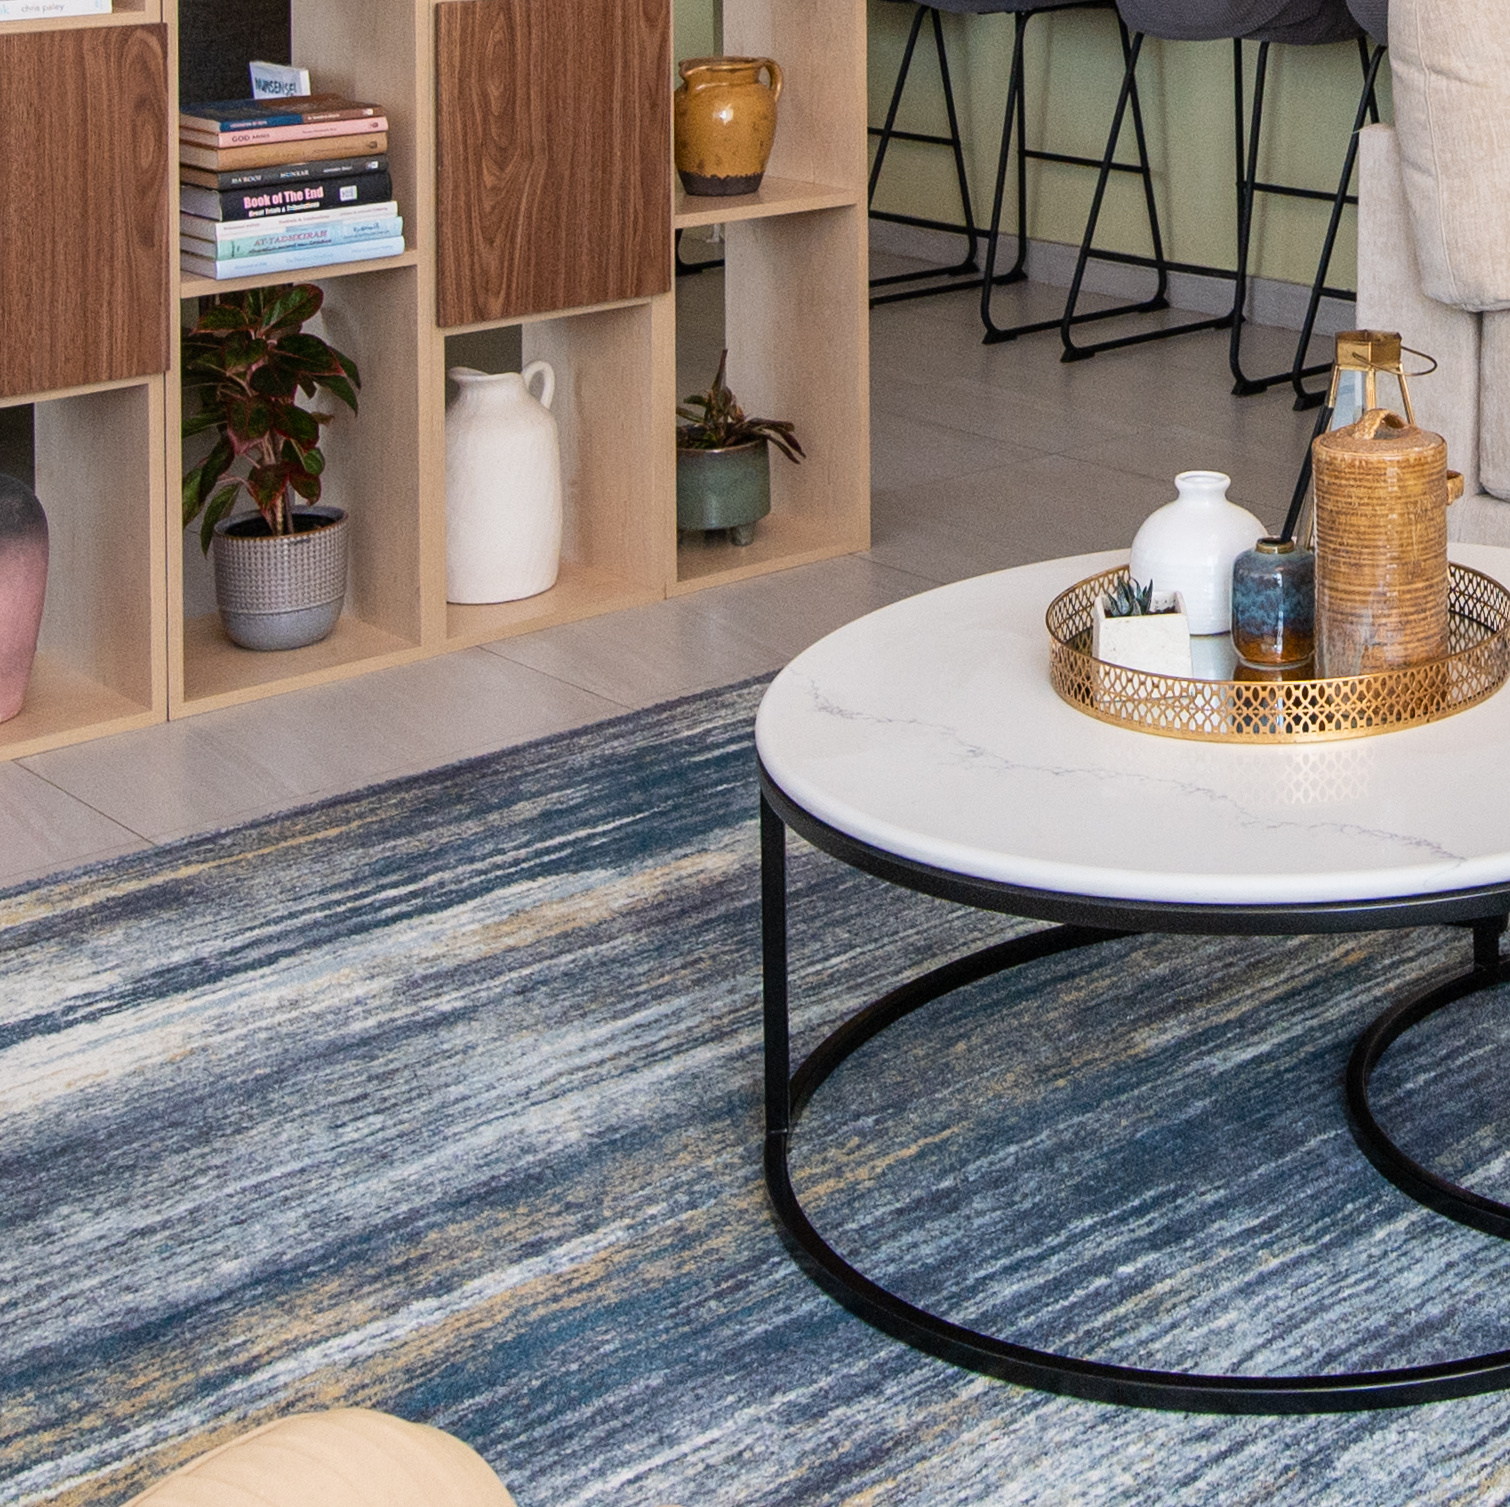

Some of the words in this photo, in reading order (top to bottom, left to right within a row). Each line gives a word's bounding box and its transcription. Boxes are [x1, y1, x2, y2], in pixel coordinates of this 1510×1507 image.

[20, 3, 40, 13] chris
[42, 2, 65, 14] paley
[232, 135, 251, 143] GOD
[243, 194, 271, 210] Book
[271, 192, 283, 205] of
[284, 190, 304, 203] The
[303, 185, 324, 200] End
[248, 209, 265, 218] Great
